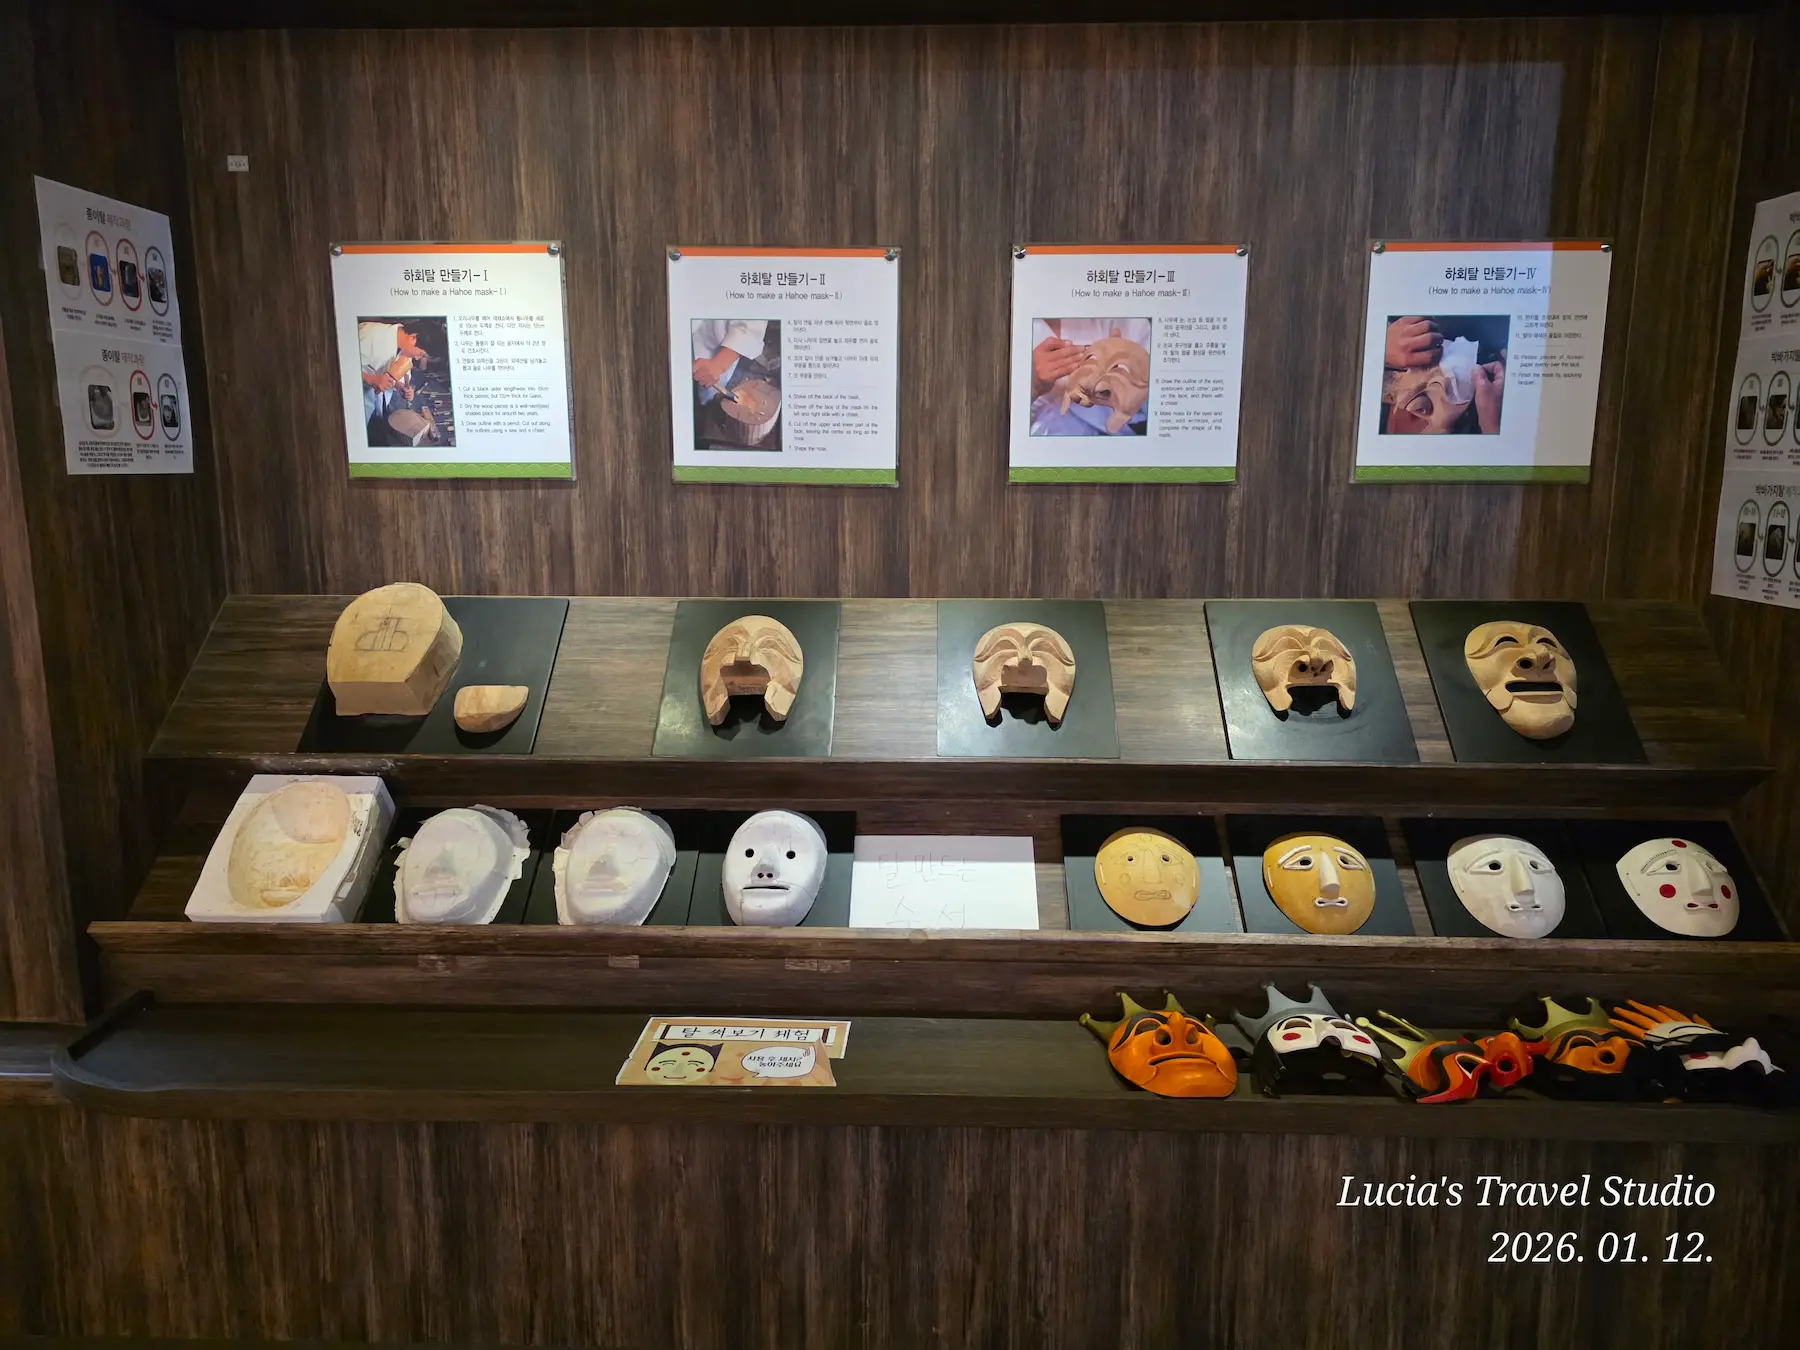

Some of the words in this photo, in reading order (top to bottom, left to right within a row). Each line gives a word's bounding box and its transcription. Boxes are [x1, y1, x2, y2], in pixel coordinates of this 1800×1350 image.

[404, 269, 435, 282] 하회탈
[740, 272, 772, 285] 하회탈
[1087, 270, 1119, 283] 하회탈
[1446, 267, 1479, 280] 하회탈
[390, 288, 409, 296] (How
[726, 291, 745, 299] (How
[1072, 289, 1091, 298] (How
[1103, 289, 1122, 297] make
[1132, 289, 1155, 297] Hahoe
[1429, 287, 1448, 295] (How
[682, 1028, 700, 1038] 탈
[708, 1027, 765, 1039] 써보기
[775, 1029, 810, 1040] 체험
